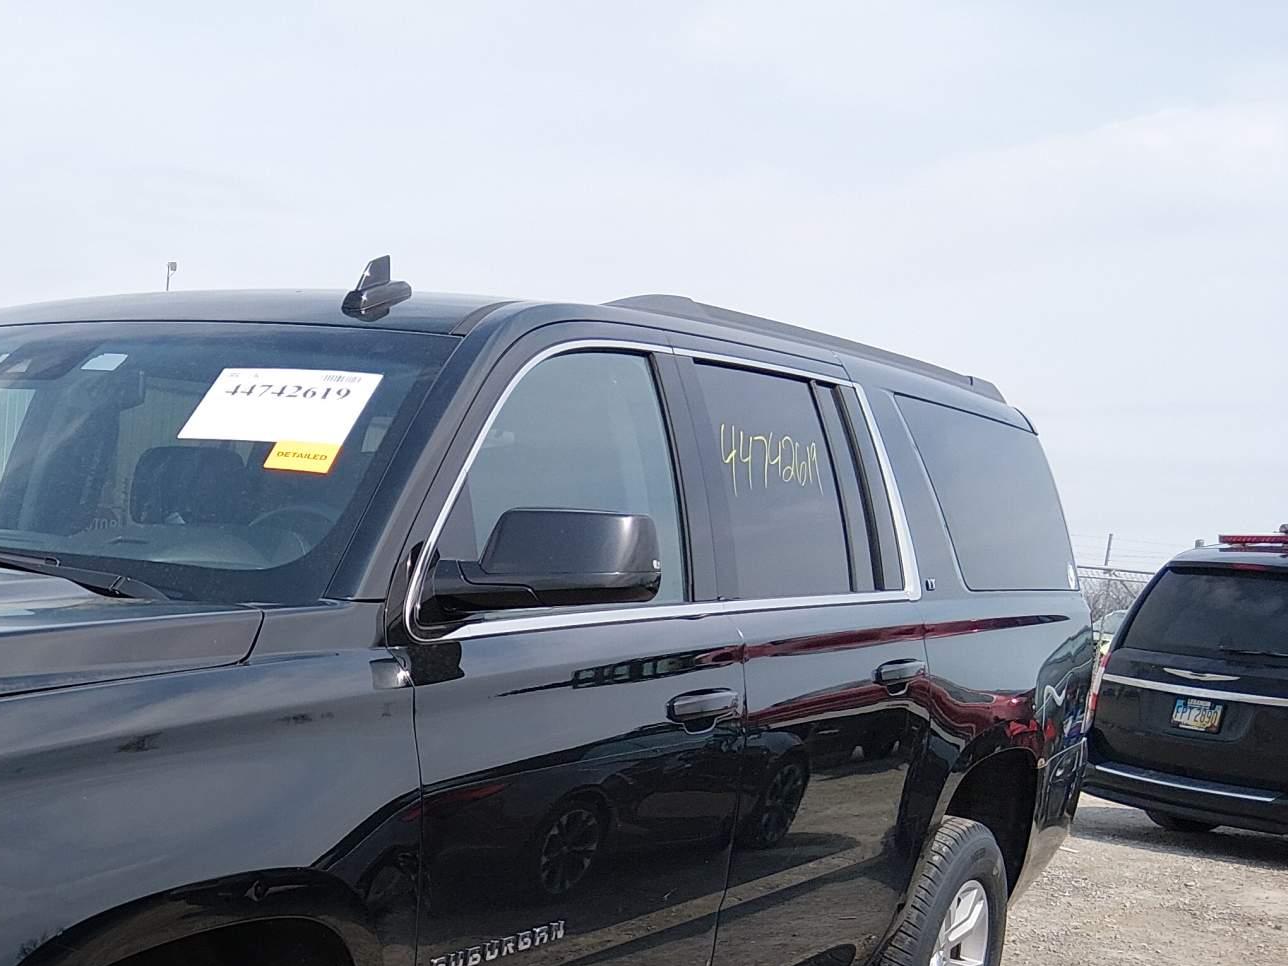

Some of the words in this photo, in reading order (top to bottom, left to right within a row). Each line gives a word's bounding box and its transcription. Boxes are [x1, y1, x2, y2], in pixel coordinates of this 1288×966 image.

[225, 383, 351, 399] 44742619
[276, 450, 328, 462] DETAILED
[721, 424, 823, 496] 44742619
[1174, 704, 1192, 721] FPT
